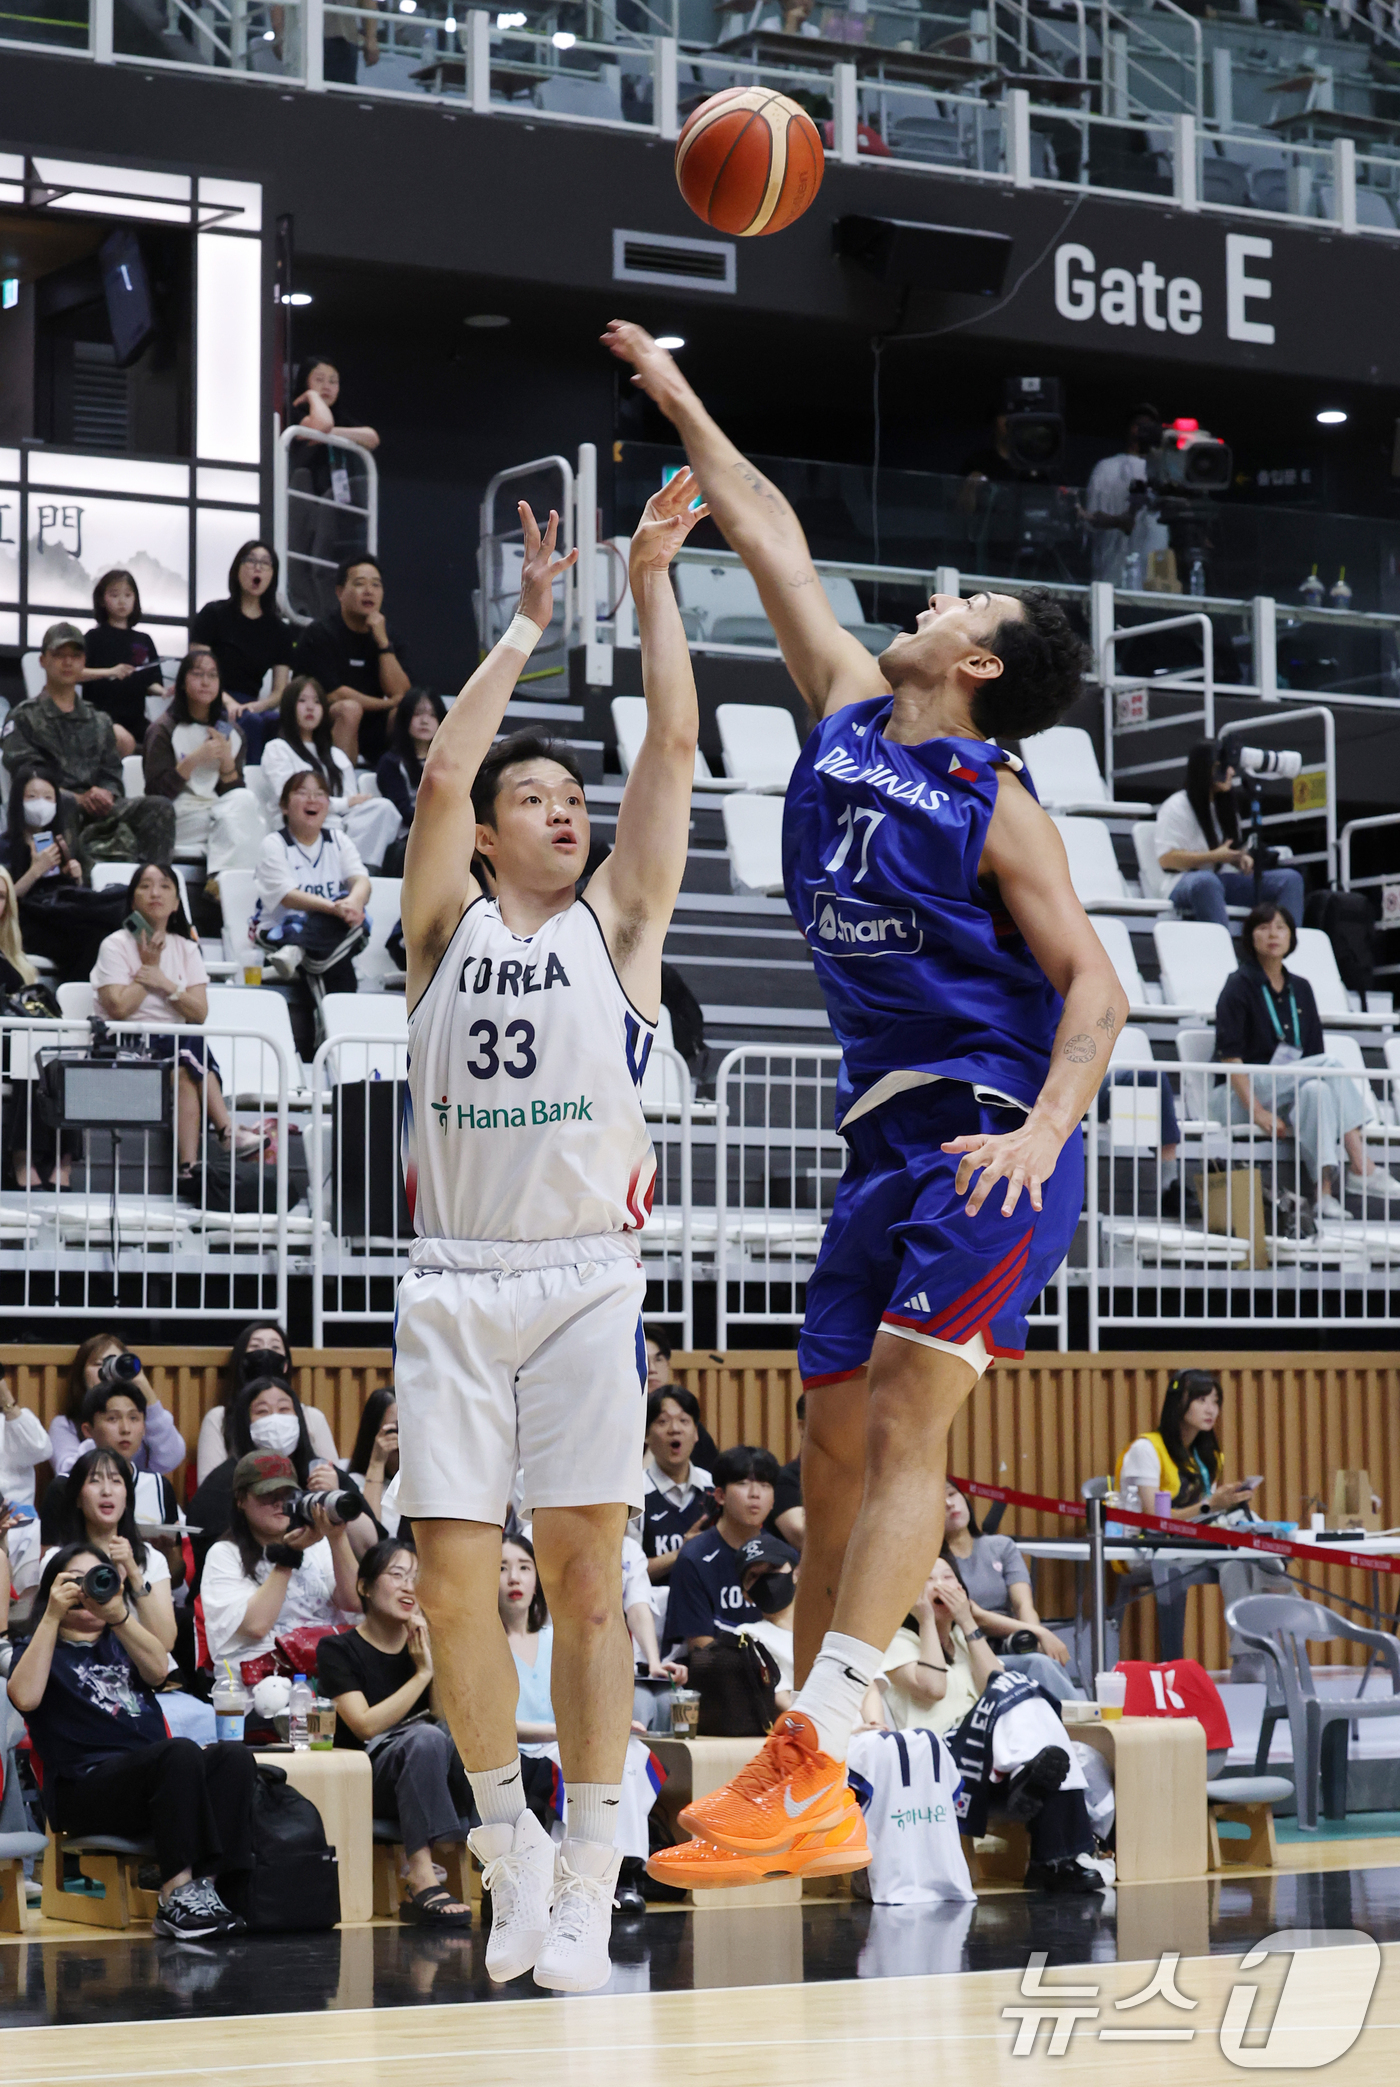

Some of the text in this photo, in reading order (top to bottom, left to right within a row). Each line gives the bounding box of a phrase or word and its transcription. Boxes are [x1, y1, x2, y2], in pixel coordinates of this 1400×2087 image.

[1054, 232, 1276, 345] Gate E
[825, 803, 887, 884] 17
[459, 952, 571, 997] KOREA
[467, 1018, 537, 1080] 33
[457, 1095, 593, 1129] Hana Bank
